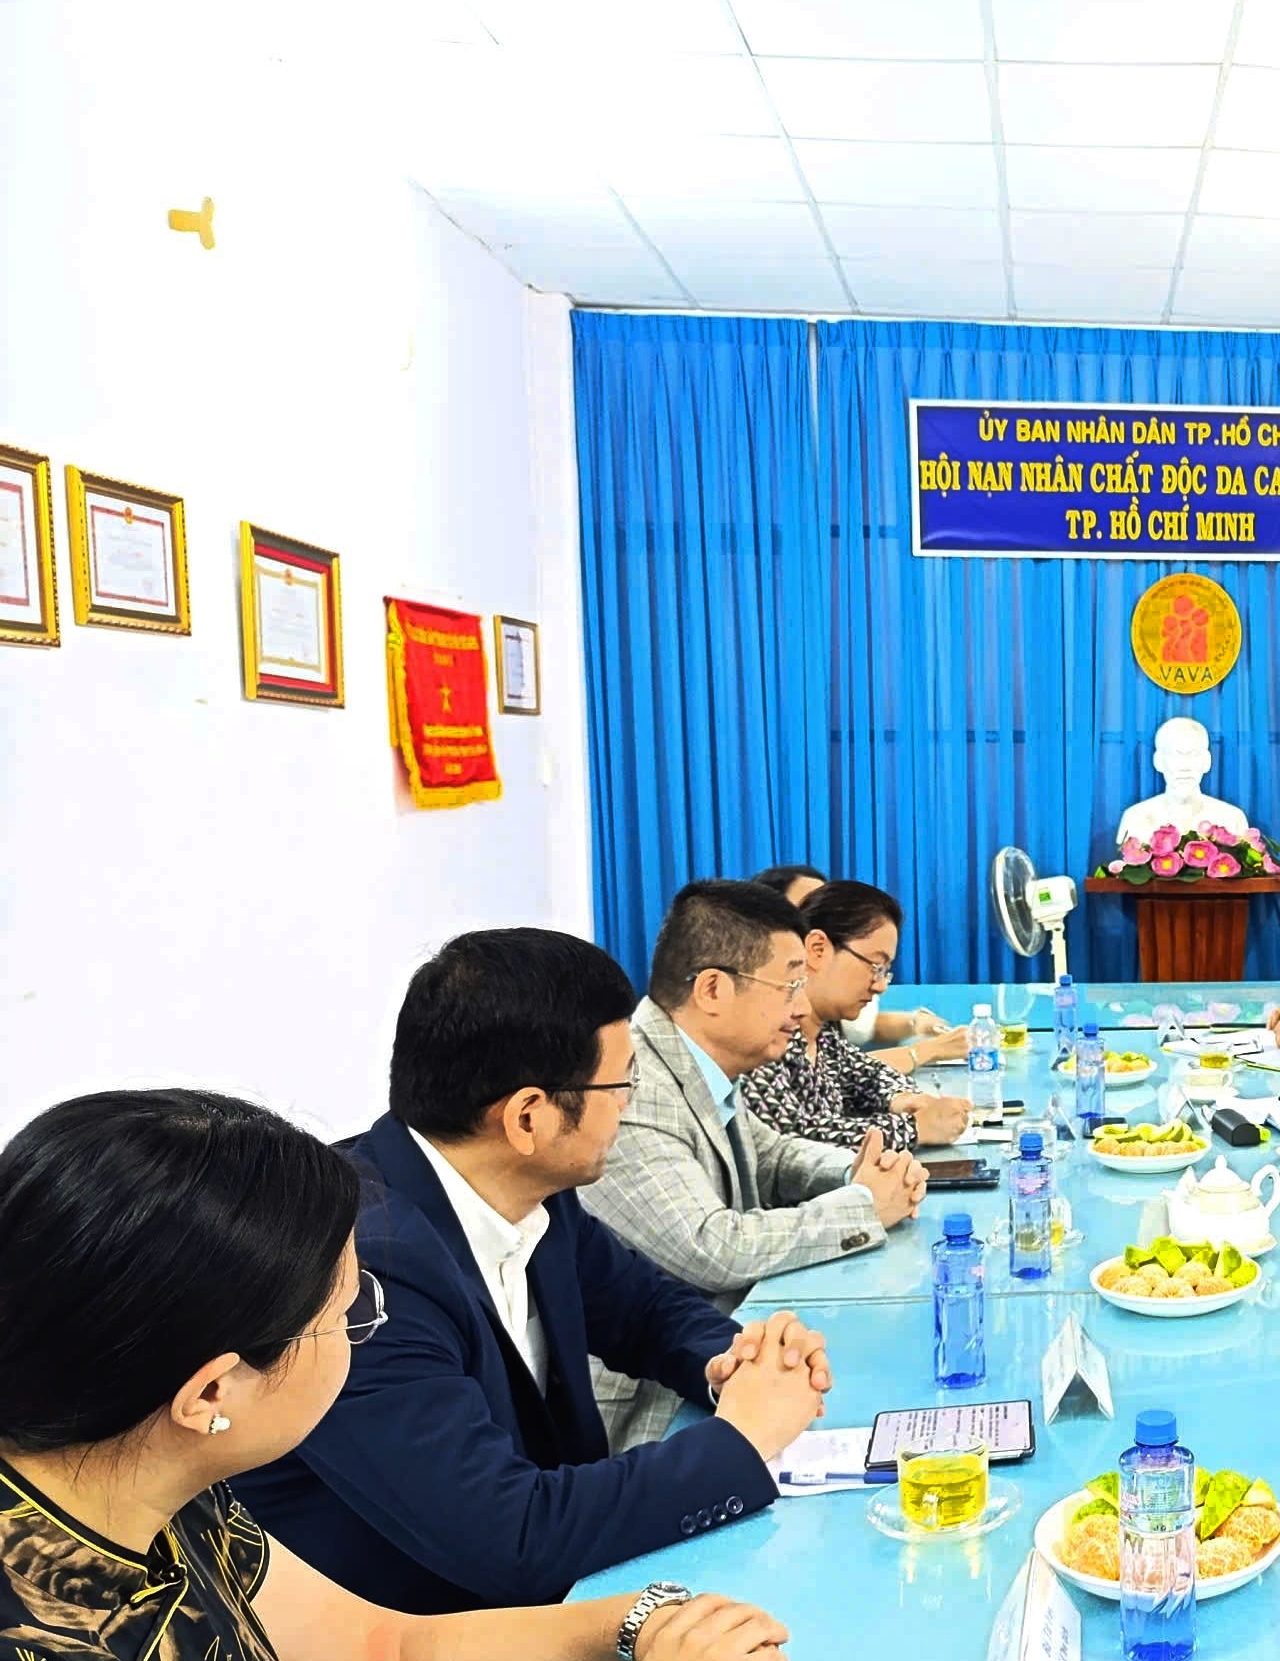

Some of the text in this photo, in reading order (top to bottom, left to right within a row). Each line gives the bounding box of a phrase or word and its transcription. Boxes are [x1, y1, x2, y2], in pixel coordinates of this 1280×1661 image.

[979, 410, 1008, 442] ỦY
[1015, 419, 1061, 443] BAN
[1066, 415, 1125, 444] NHÂN
[1132, 417, 1176, 445] DÂN
[919, 452, 961, 498] HỘI
[967, 461, 1013, 498] NẠN
[1020, 454, 1084, 492] NHÂN
[1090, 450, 1154, 493] CHẤT
[1161, 456, 1207, 502] ĐỘC
[1216, 465, 1247, 495] DA
[1065, 495, 1255, 541] TP. HỒ CHÍ MINH
[1159, 664, 1214, 682] VAVA
